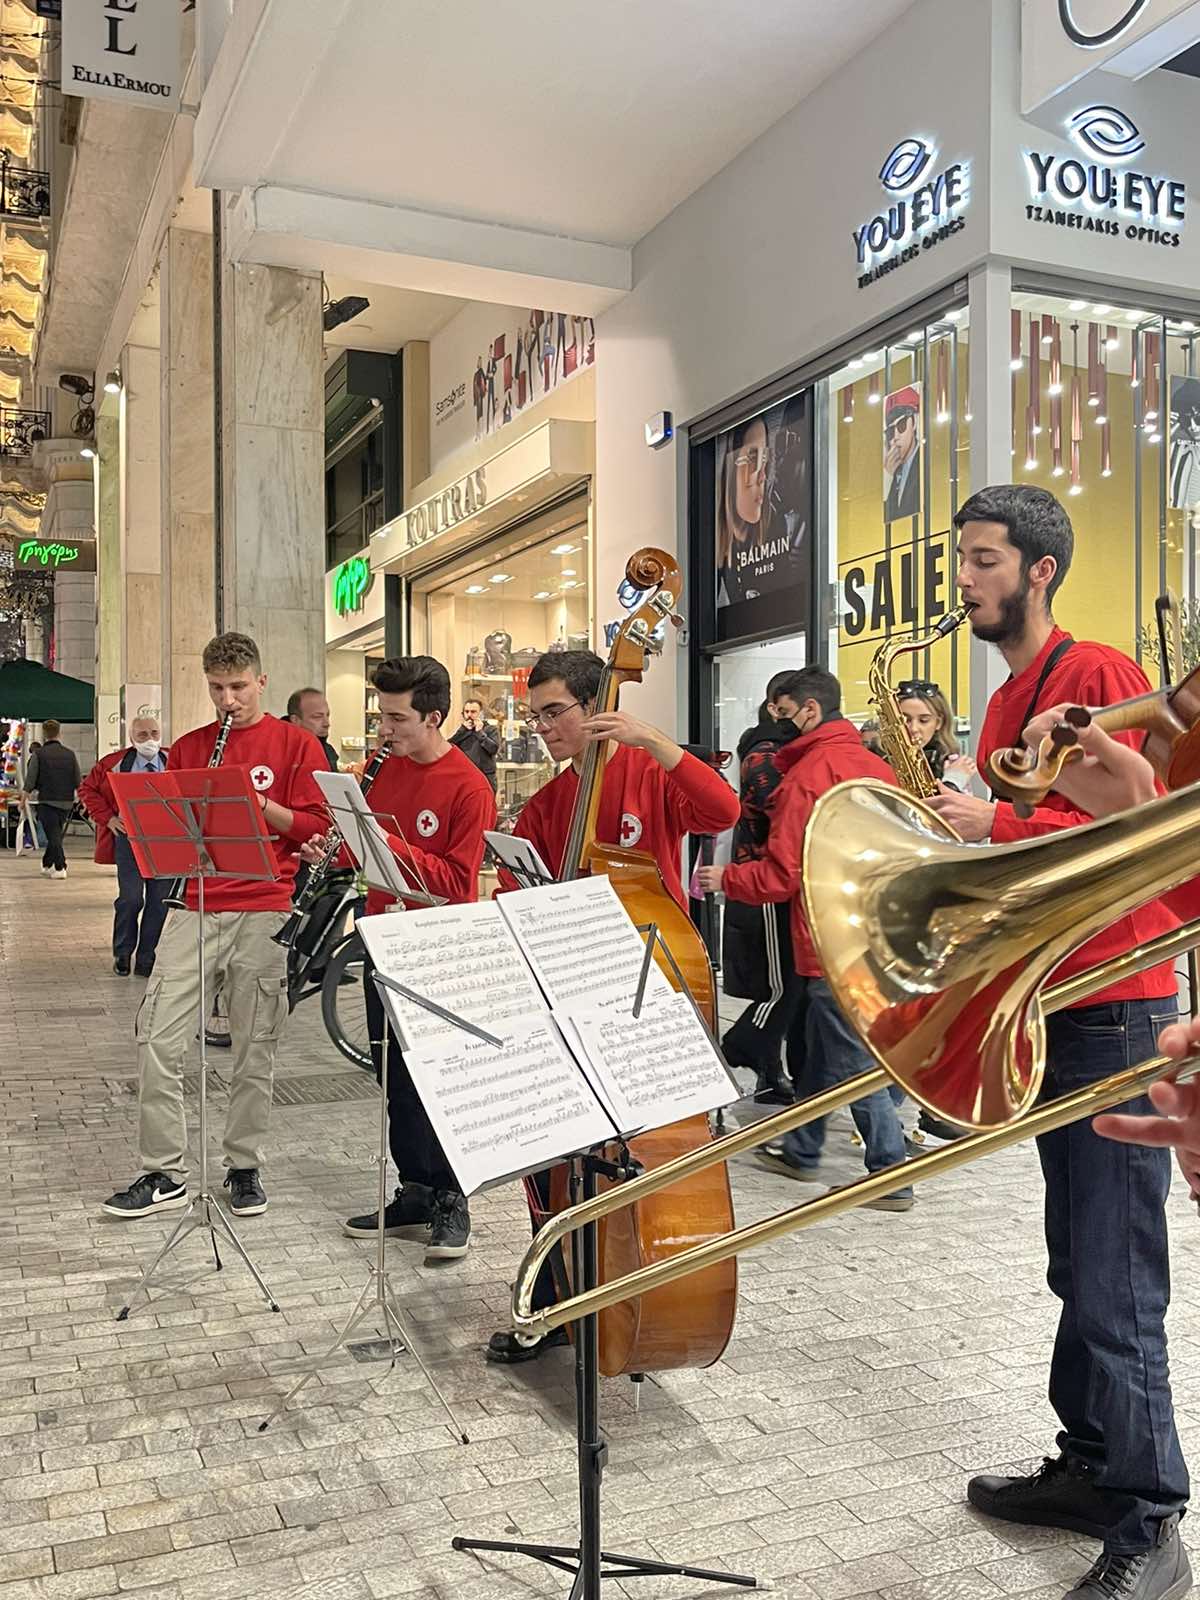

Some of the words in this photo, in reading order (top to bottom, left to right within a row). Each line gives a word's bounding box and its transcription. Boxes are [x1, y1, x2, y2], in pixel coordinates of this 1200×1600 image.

[852, 201, 906, 263] YOU
[911, 164, 962, 232] EYE
[1029, 152, 1112, 205] YOU
[1123, 172, 1185, 220] EYE
[1025, 204, 1120, 236] TZANETAKIS
[1125, 224, 1181, 248] OPTICS
[405, 466, 487, 547] KOUTRAS
[740, 535, 790, 568] BALMAIN
[754, 562, 775, 577] PARIS
[844, 543, 945, 637] SALE
